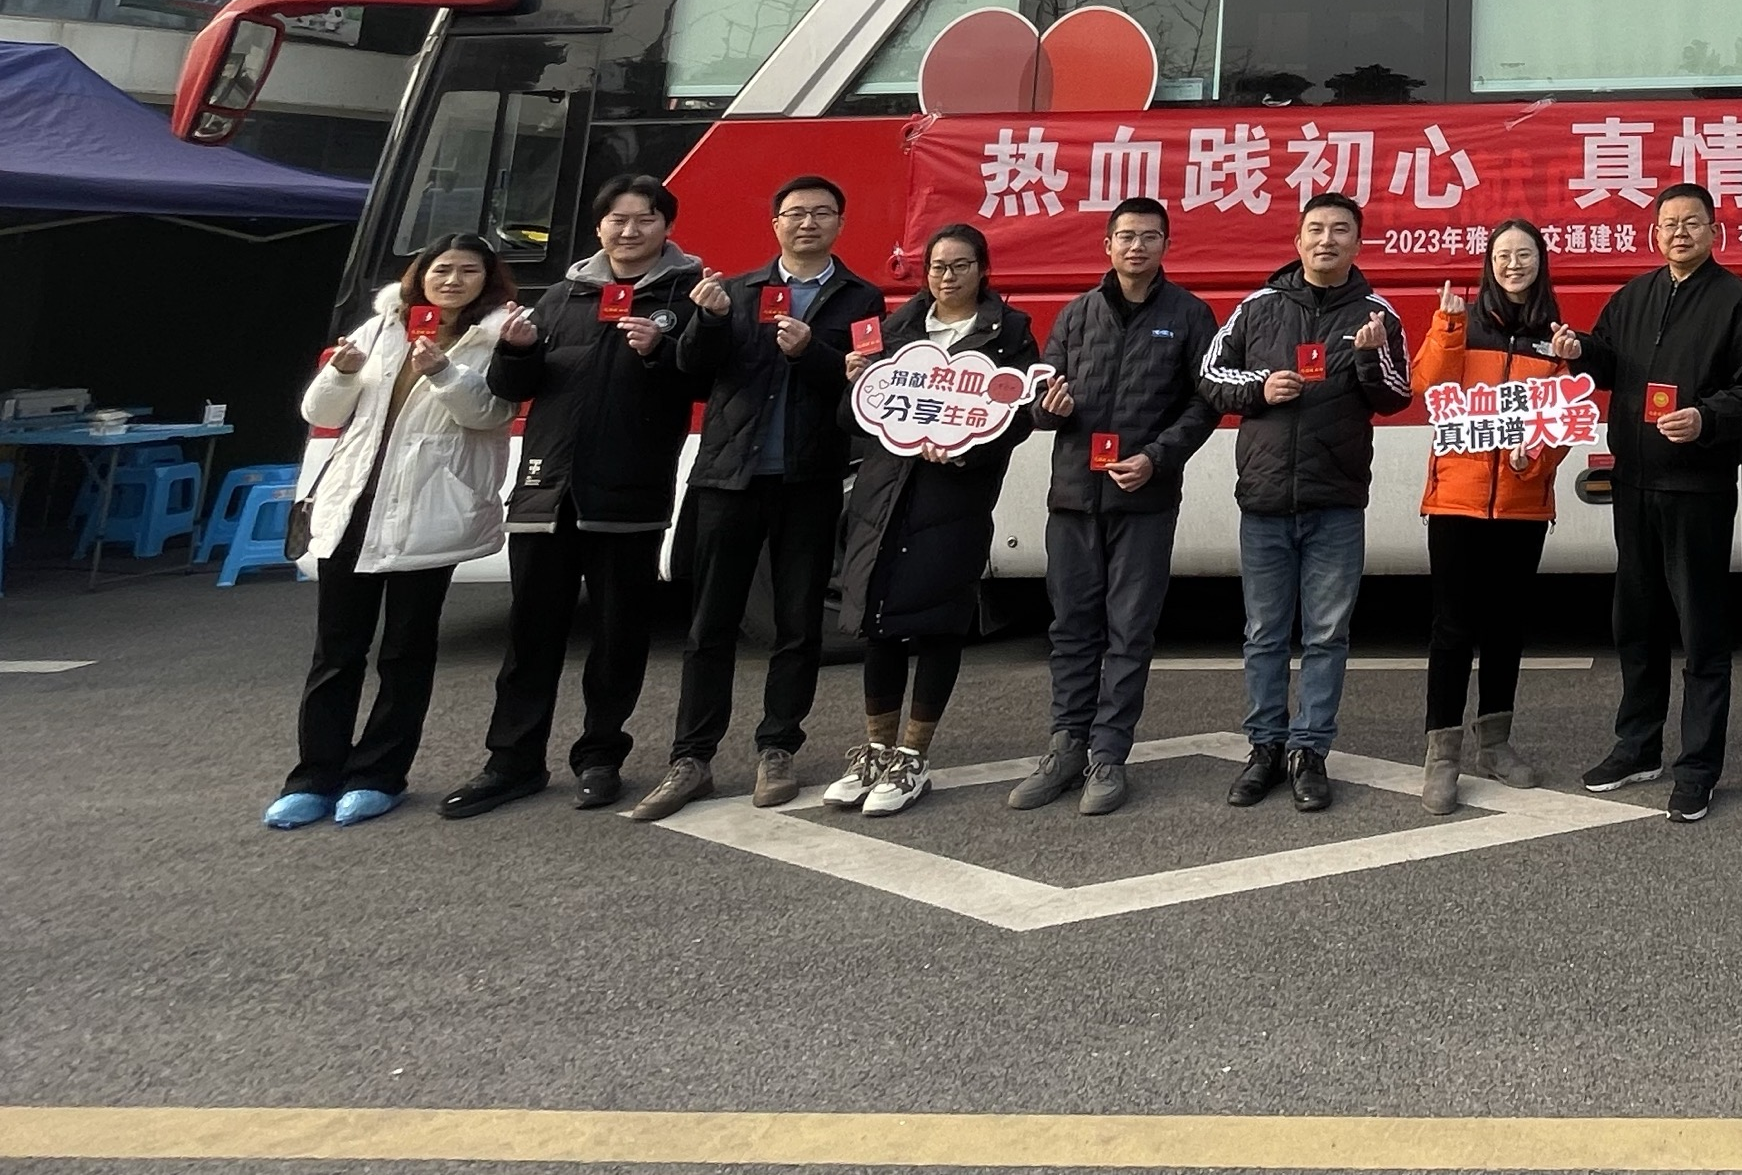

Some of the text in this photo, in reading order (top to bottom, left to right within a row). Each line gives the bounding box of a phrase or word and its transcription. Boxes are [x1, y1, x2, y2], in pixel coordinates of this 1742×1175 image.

[979, 122, 1481, 218] 热血践初心
[890, 366, 985, 396] 捐献热血
[880, 394, 990, 428] 分享生命
[1437, 404, 1597, 452] 真情谱大爱
